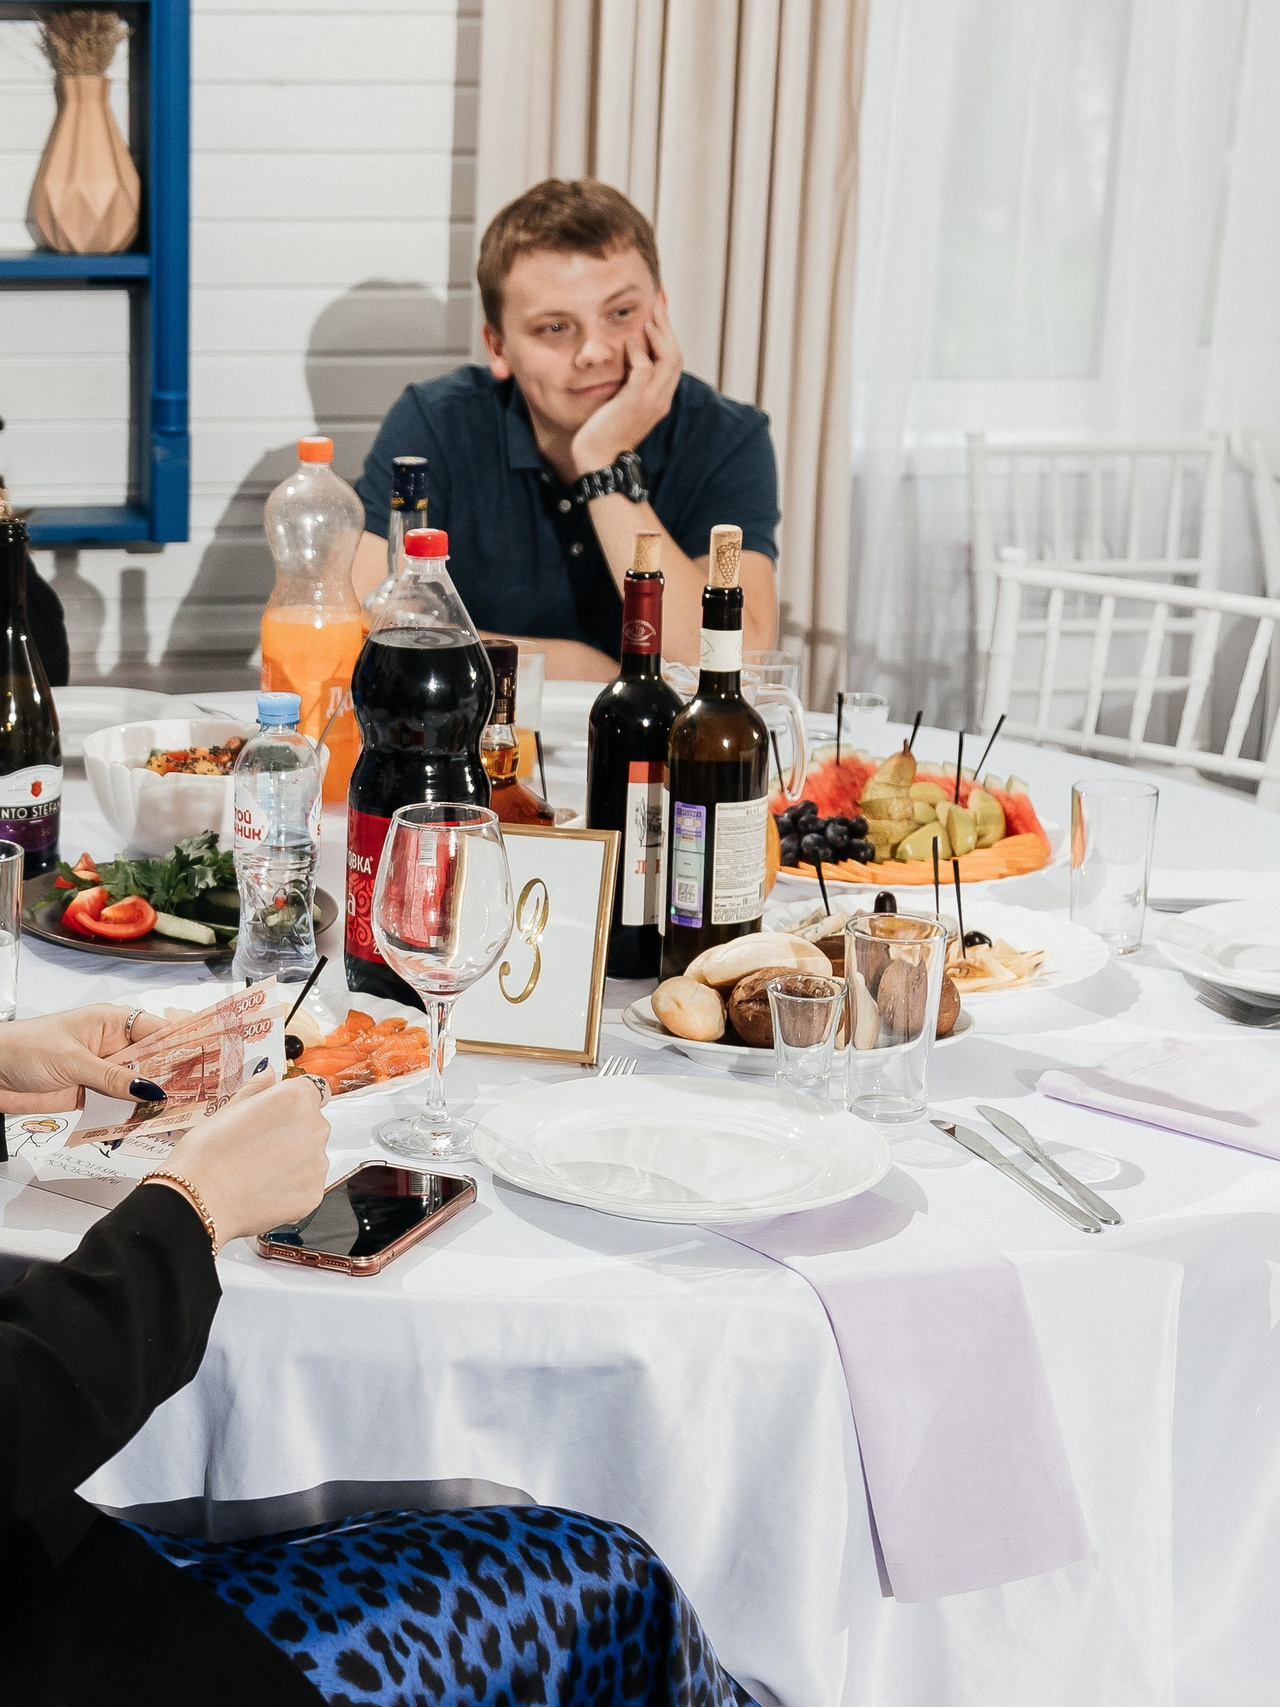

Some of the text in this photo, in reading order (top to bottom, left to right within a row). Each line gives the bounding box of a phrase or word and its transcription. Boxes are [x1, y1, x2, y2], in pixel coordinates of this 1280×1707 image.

[499, 878, 549, 1004] 3
[236, 992, 264, 1014] 5000
[242, 1021, 271, 1039] 5000
